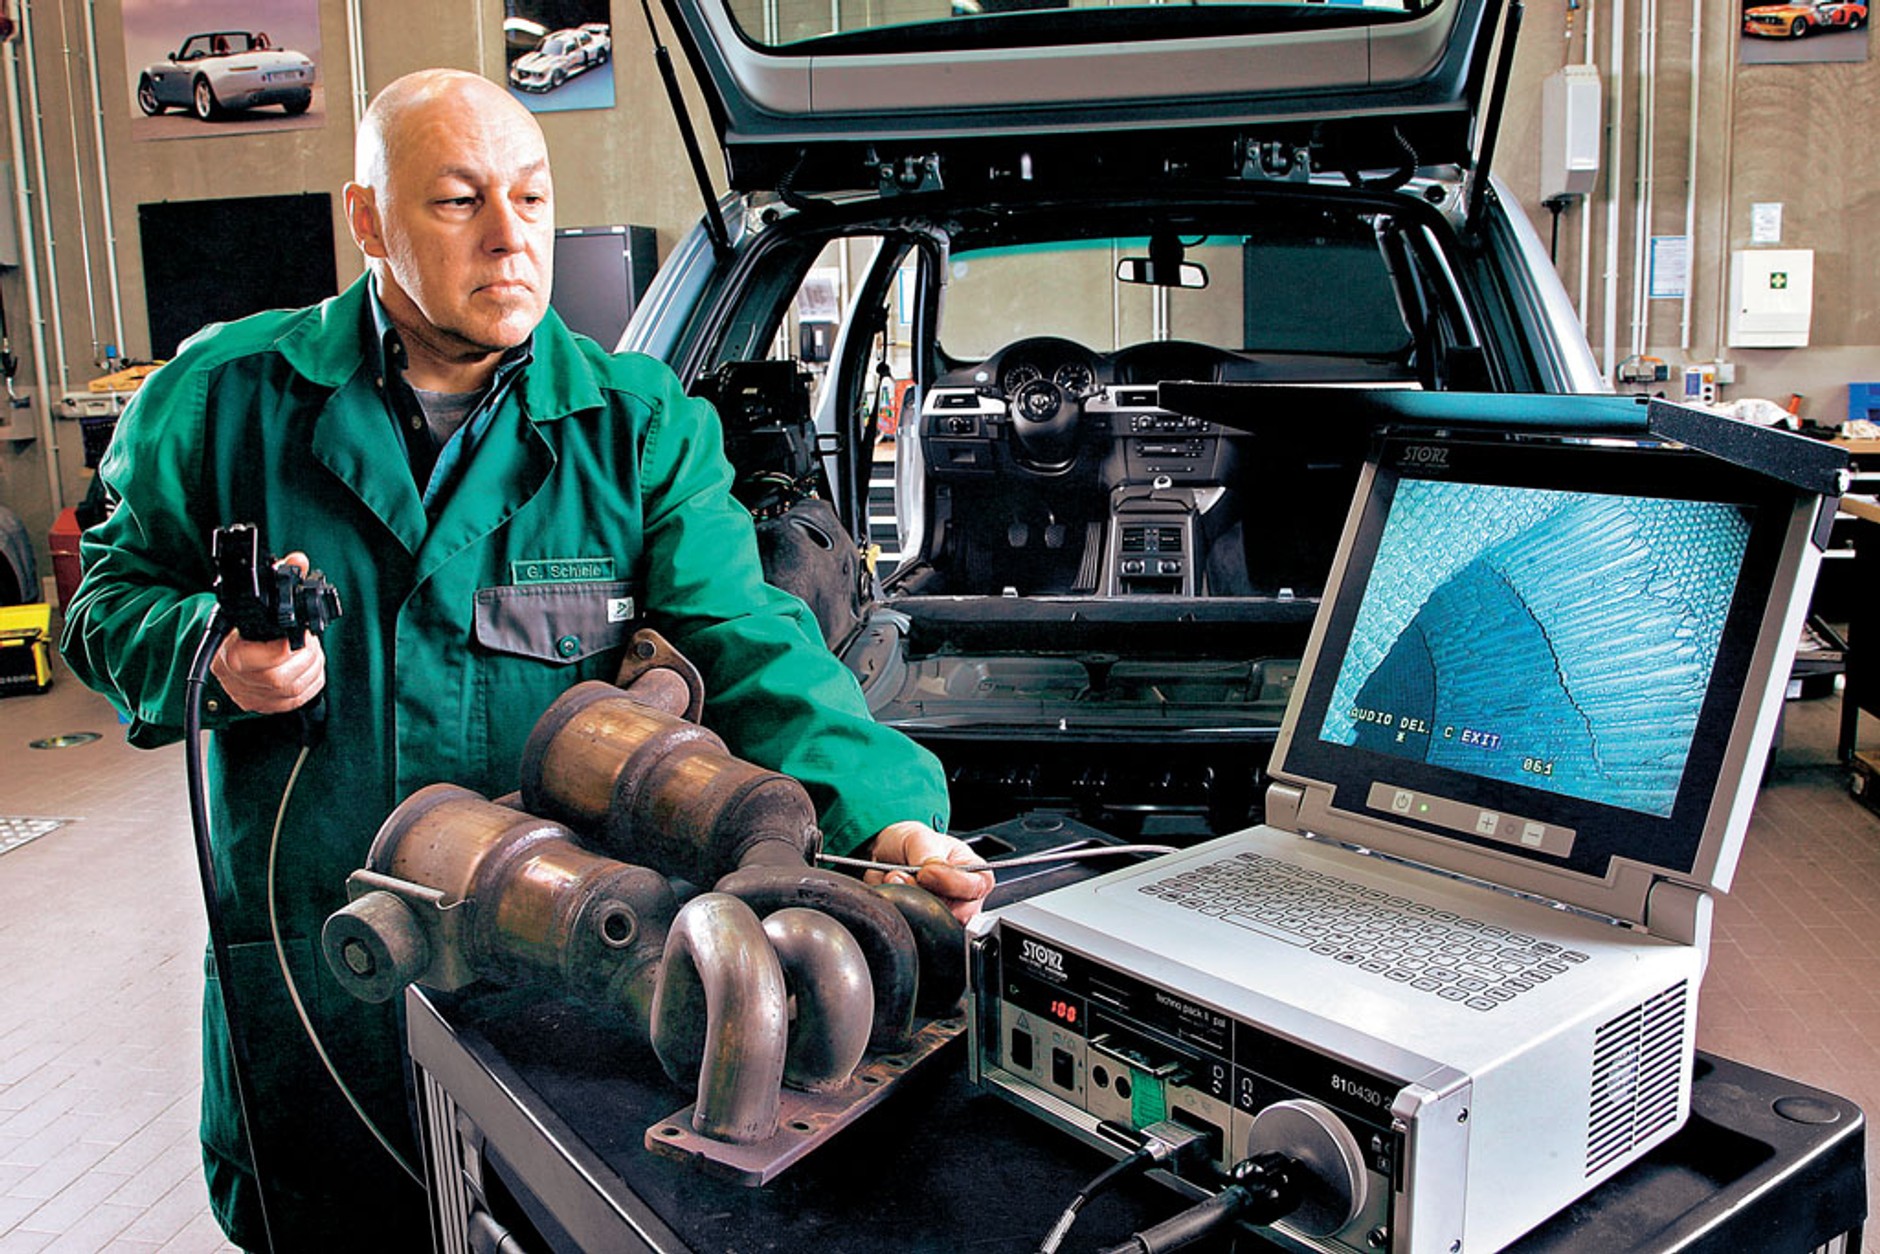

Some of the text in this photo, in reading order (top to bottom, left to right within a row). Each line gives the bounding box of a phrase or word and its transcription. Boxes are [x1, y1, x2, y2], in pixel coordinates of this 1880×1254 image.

[1403, 446, 1449, 463] STORZ
[526, 563, 602, 578] G. Schiele
[1350, 707, 1393, 725] AUDIO
[1400, 716, 1430, 734] DEL.
[1461, 729, 1500, 748] EXIT
[1023, 940, 1064, 971] STORZ
[1331, 1074, 1381, 1107] 810430
